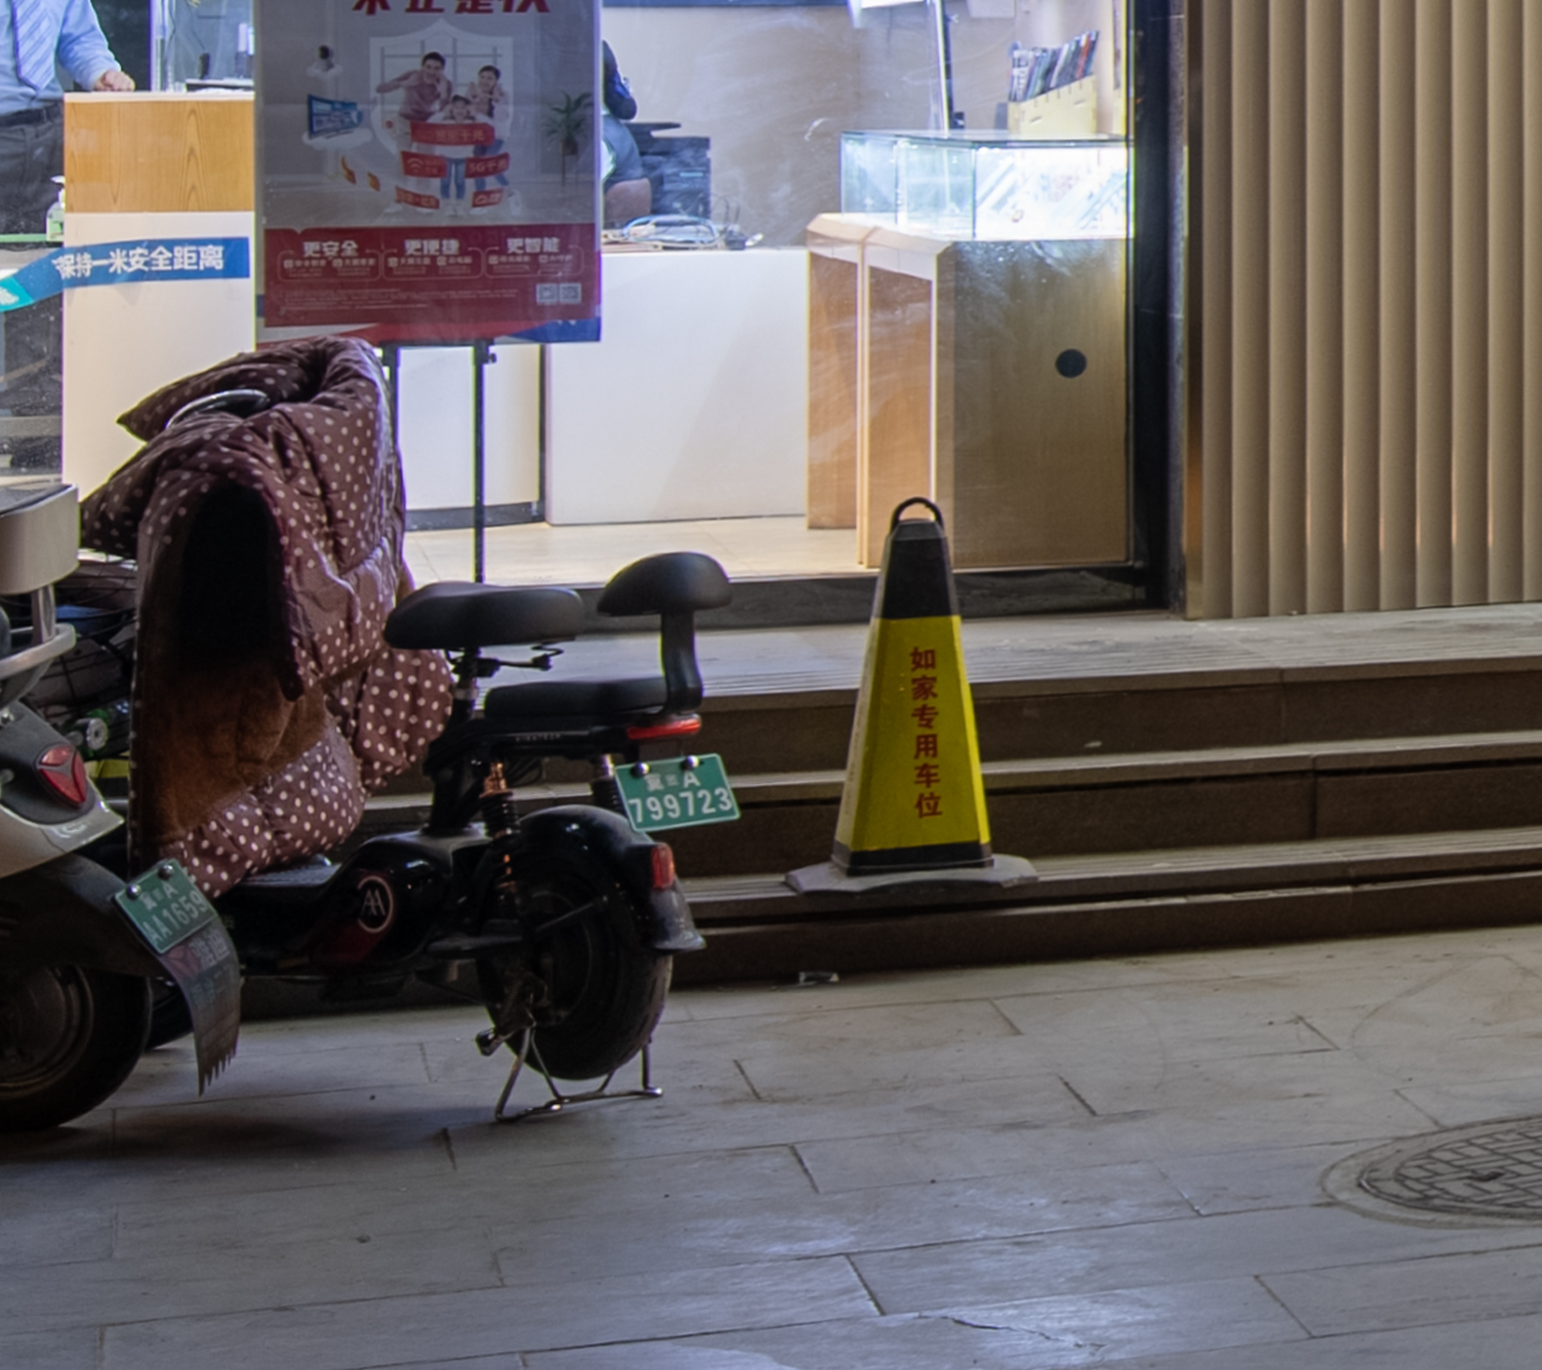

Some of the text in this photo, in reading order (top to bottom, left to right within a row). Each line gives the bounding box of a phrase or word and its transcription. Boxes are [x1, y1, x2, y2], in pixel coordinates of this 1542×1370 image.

[51, 244, 225, 281] 保持一米安全距离
[303, 239, 359, 258] 更安全
[909, 646, 943, 819] 如家专用车位
[627, 786, 733, 824] 799723
[142, 889, 209, 946] AA1659
